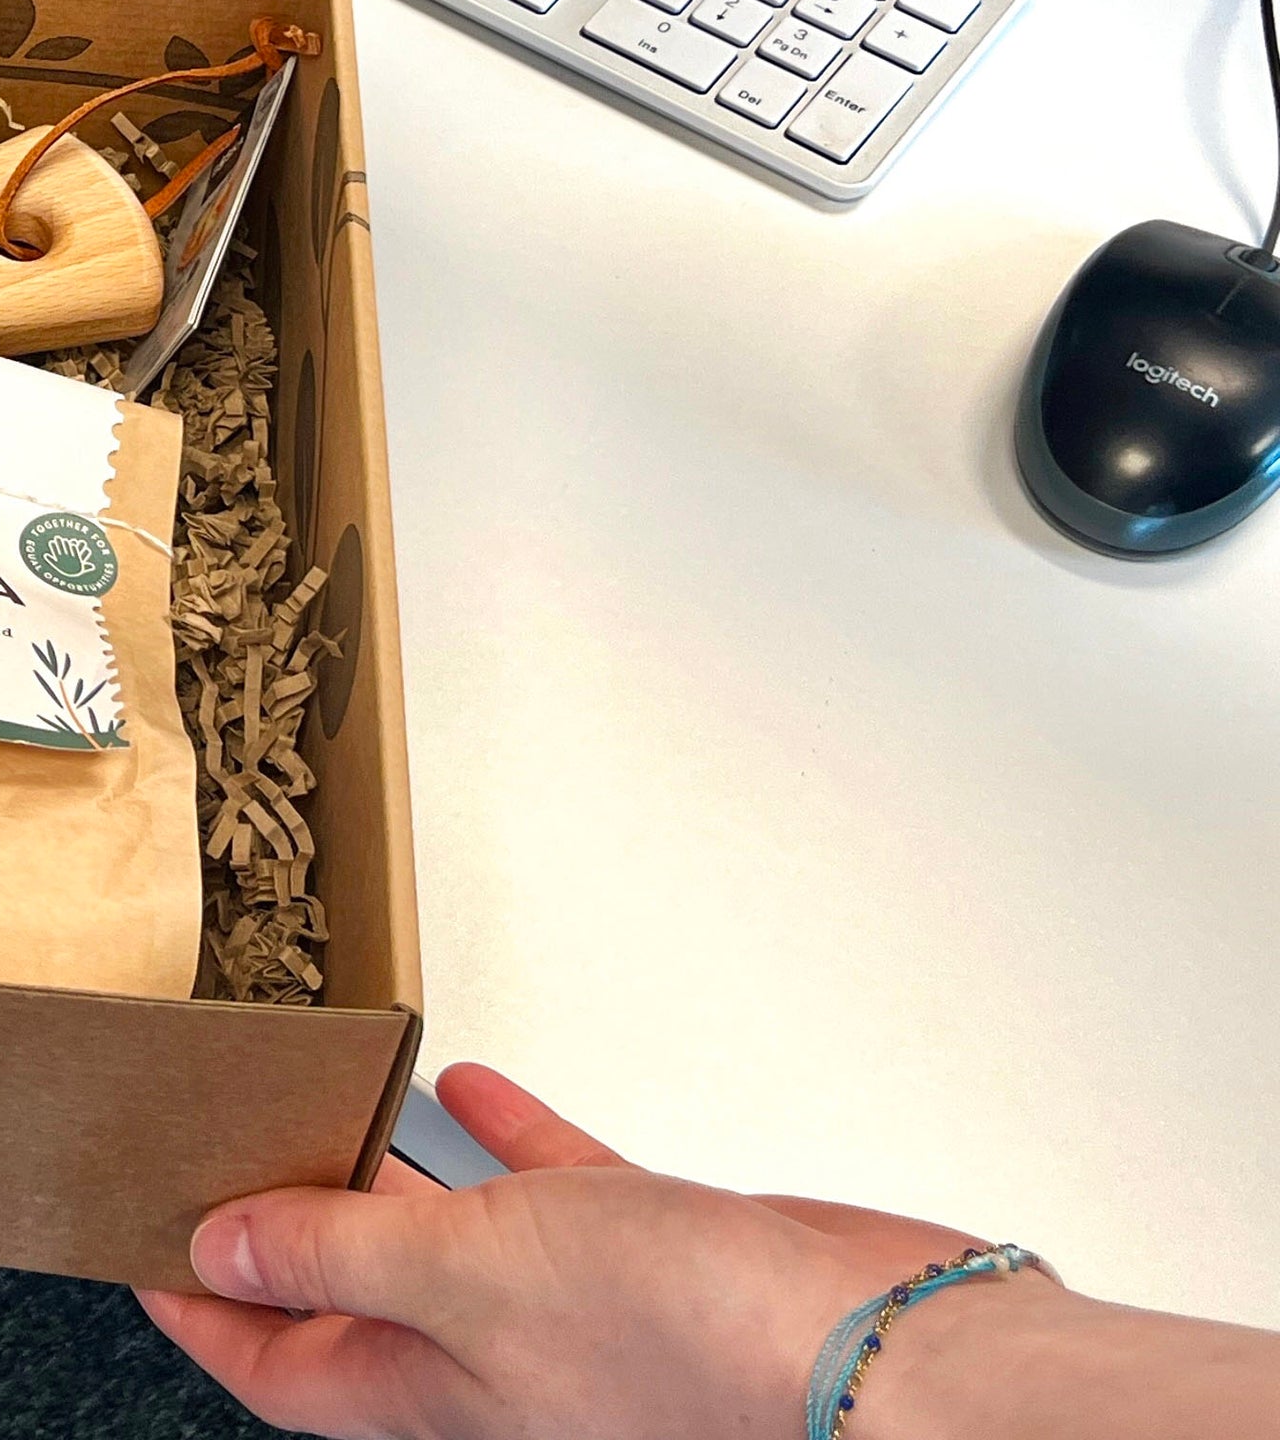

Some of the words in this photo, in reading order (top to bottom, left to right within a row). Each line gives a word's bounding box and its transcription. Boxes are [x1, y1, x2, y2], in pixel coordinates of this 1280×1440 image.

[657, 21, 671, 33] 0
[793, 29, 809, 41] 3
[638, 39, 658, 54] Ins
[773, 38, 789, 51] Pg
[790, 47, 808, 60] Dn
[737, 89, 762, 106] Del
[824, 89, 867, 115] Enter
[1126, 352, 1220, 408] logitech
[31, 519, 90, 537] TOGETHER
[91, 533, 110, 556] FOR
[26, 539, 42, 572] EQUAL
[44, 563, 114, 592] OPPORTUNITIES
